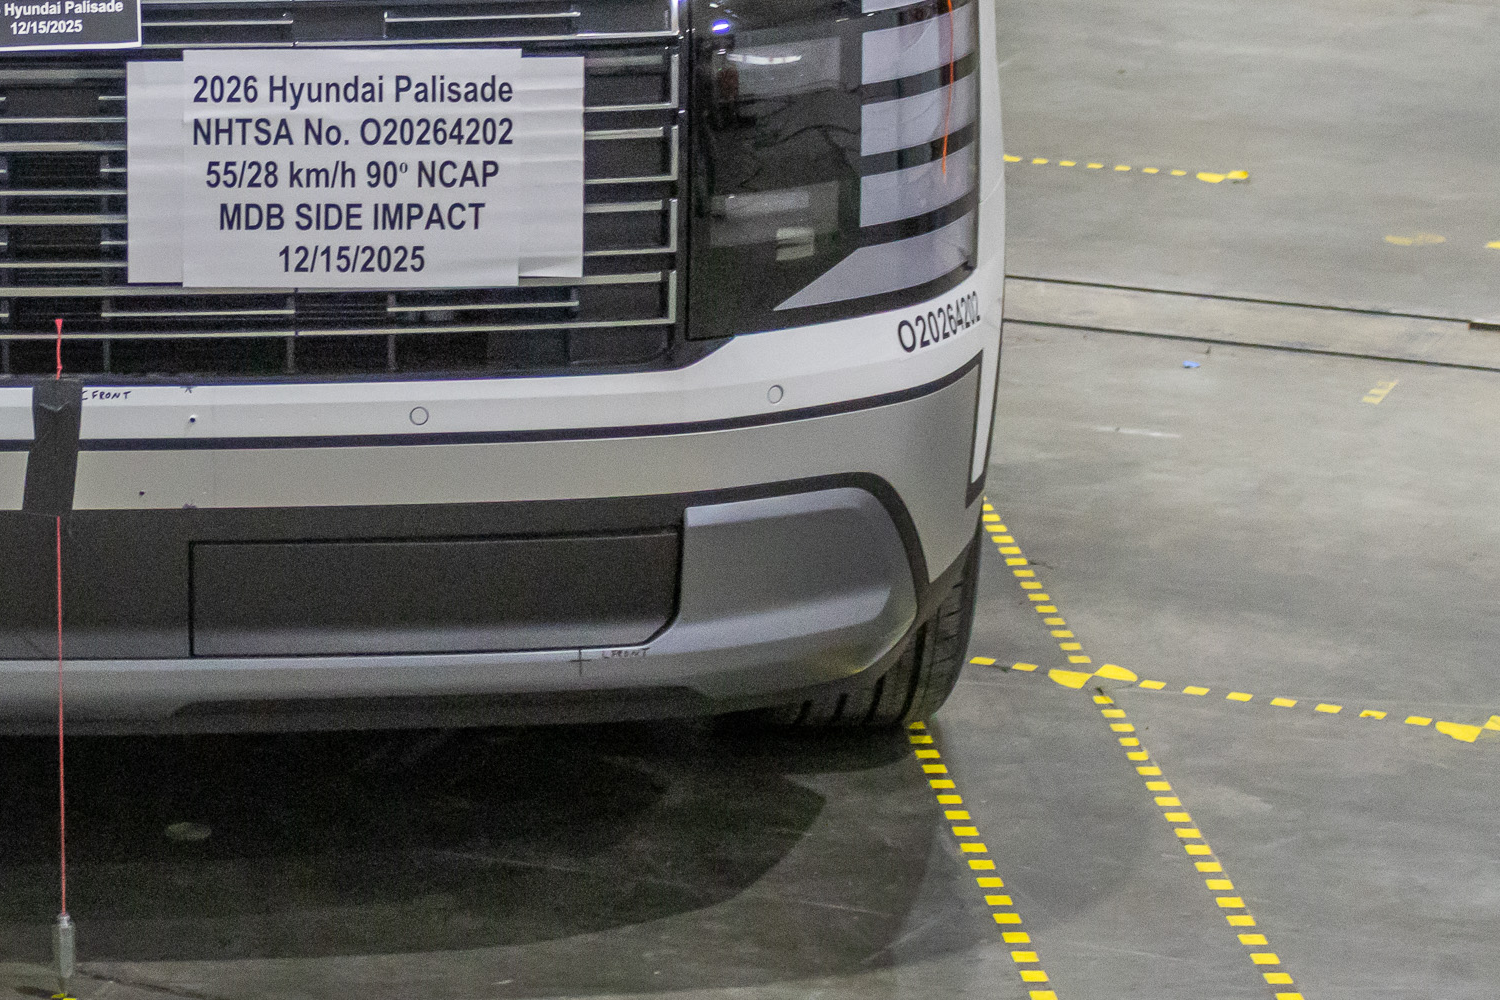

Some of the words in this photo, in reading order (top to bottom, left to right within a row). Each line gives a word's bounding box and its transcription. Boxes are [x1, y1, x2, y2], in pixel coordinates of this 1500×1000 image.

[4, 2, 61, 19] Hyundai
[65, 0, 123, 14] Palisade
[10, 20, 83, 35] 12/15/2025
[193, 75, 259, 103] 2026
[268, 75, 384, 110] Hyundai
[394, 75, 513, 103] Palisade
[192, 118, 294, 146] NHTSA
[304, 118, 350, 146] No.
[206, 160, 279, 189] 55/28
[289, 160, 356, 189] km/h
[417, 160, 499, 188] NCAP
[219, 203, 284, 231] MDB
[295, 203, 362, 230] SIDE
[373, 203, 486, 230] IMPACT
[279, 246, 425, 273] 12/15/2025
